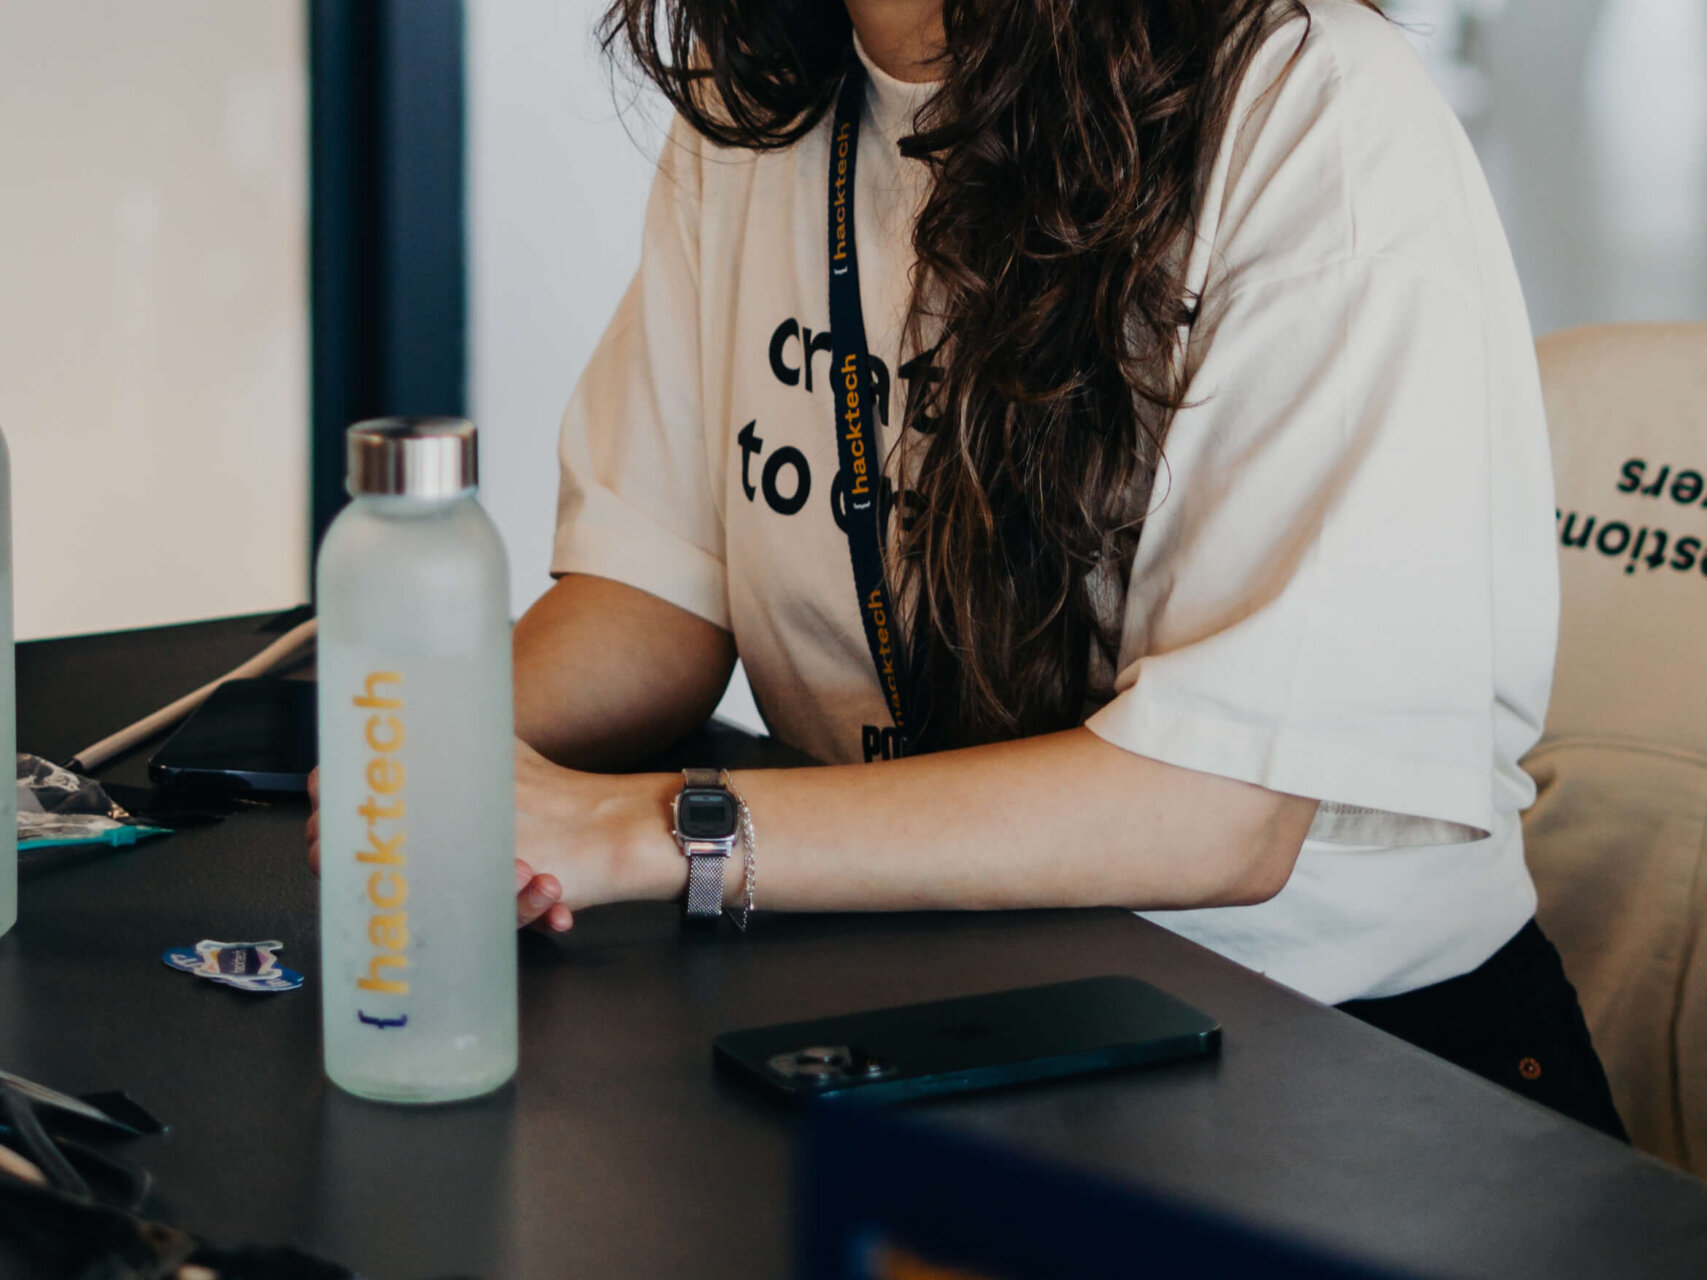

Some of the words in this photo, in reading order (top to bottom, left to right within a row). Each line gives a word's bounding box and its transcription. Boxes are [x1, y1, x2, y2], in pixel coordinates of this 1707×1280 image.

[738, 419, 812, 516] to
[841, 353, 871, 495] hacktech
[352, 669, 409, 995] hacktech
